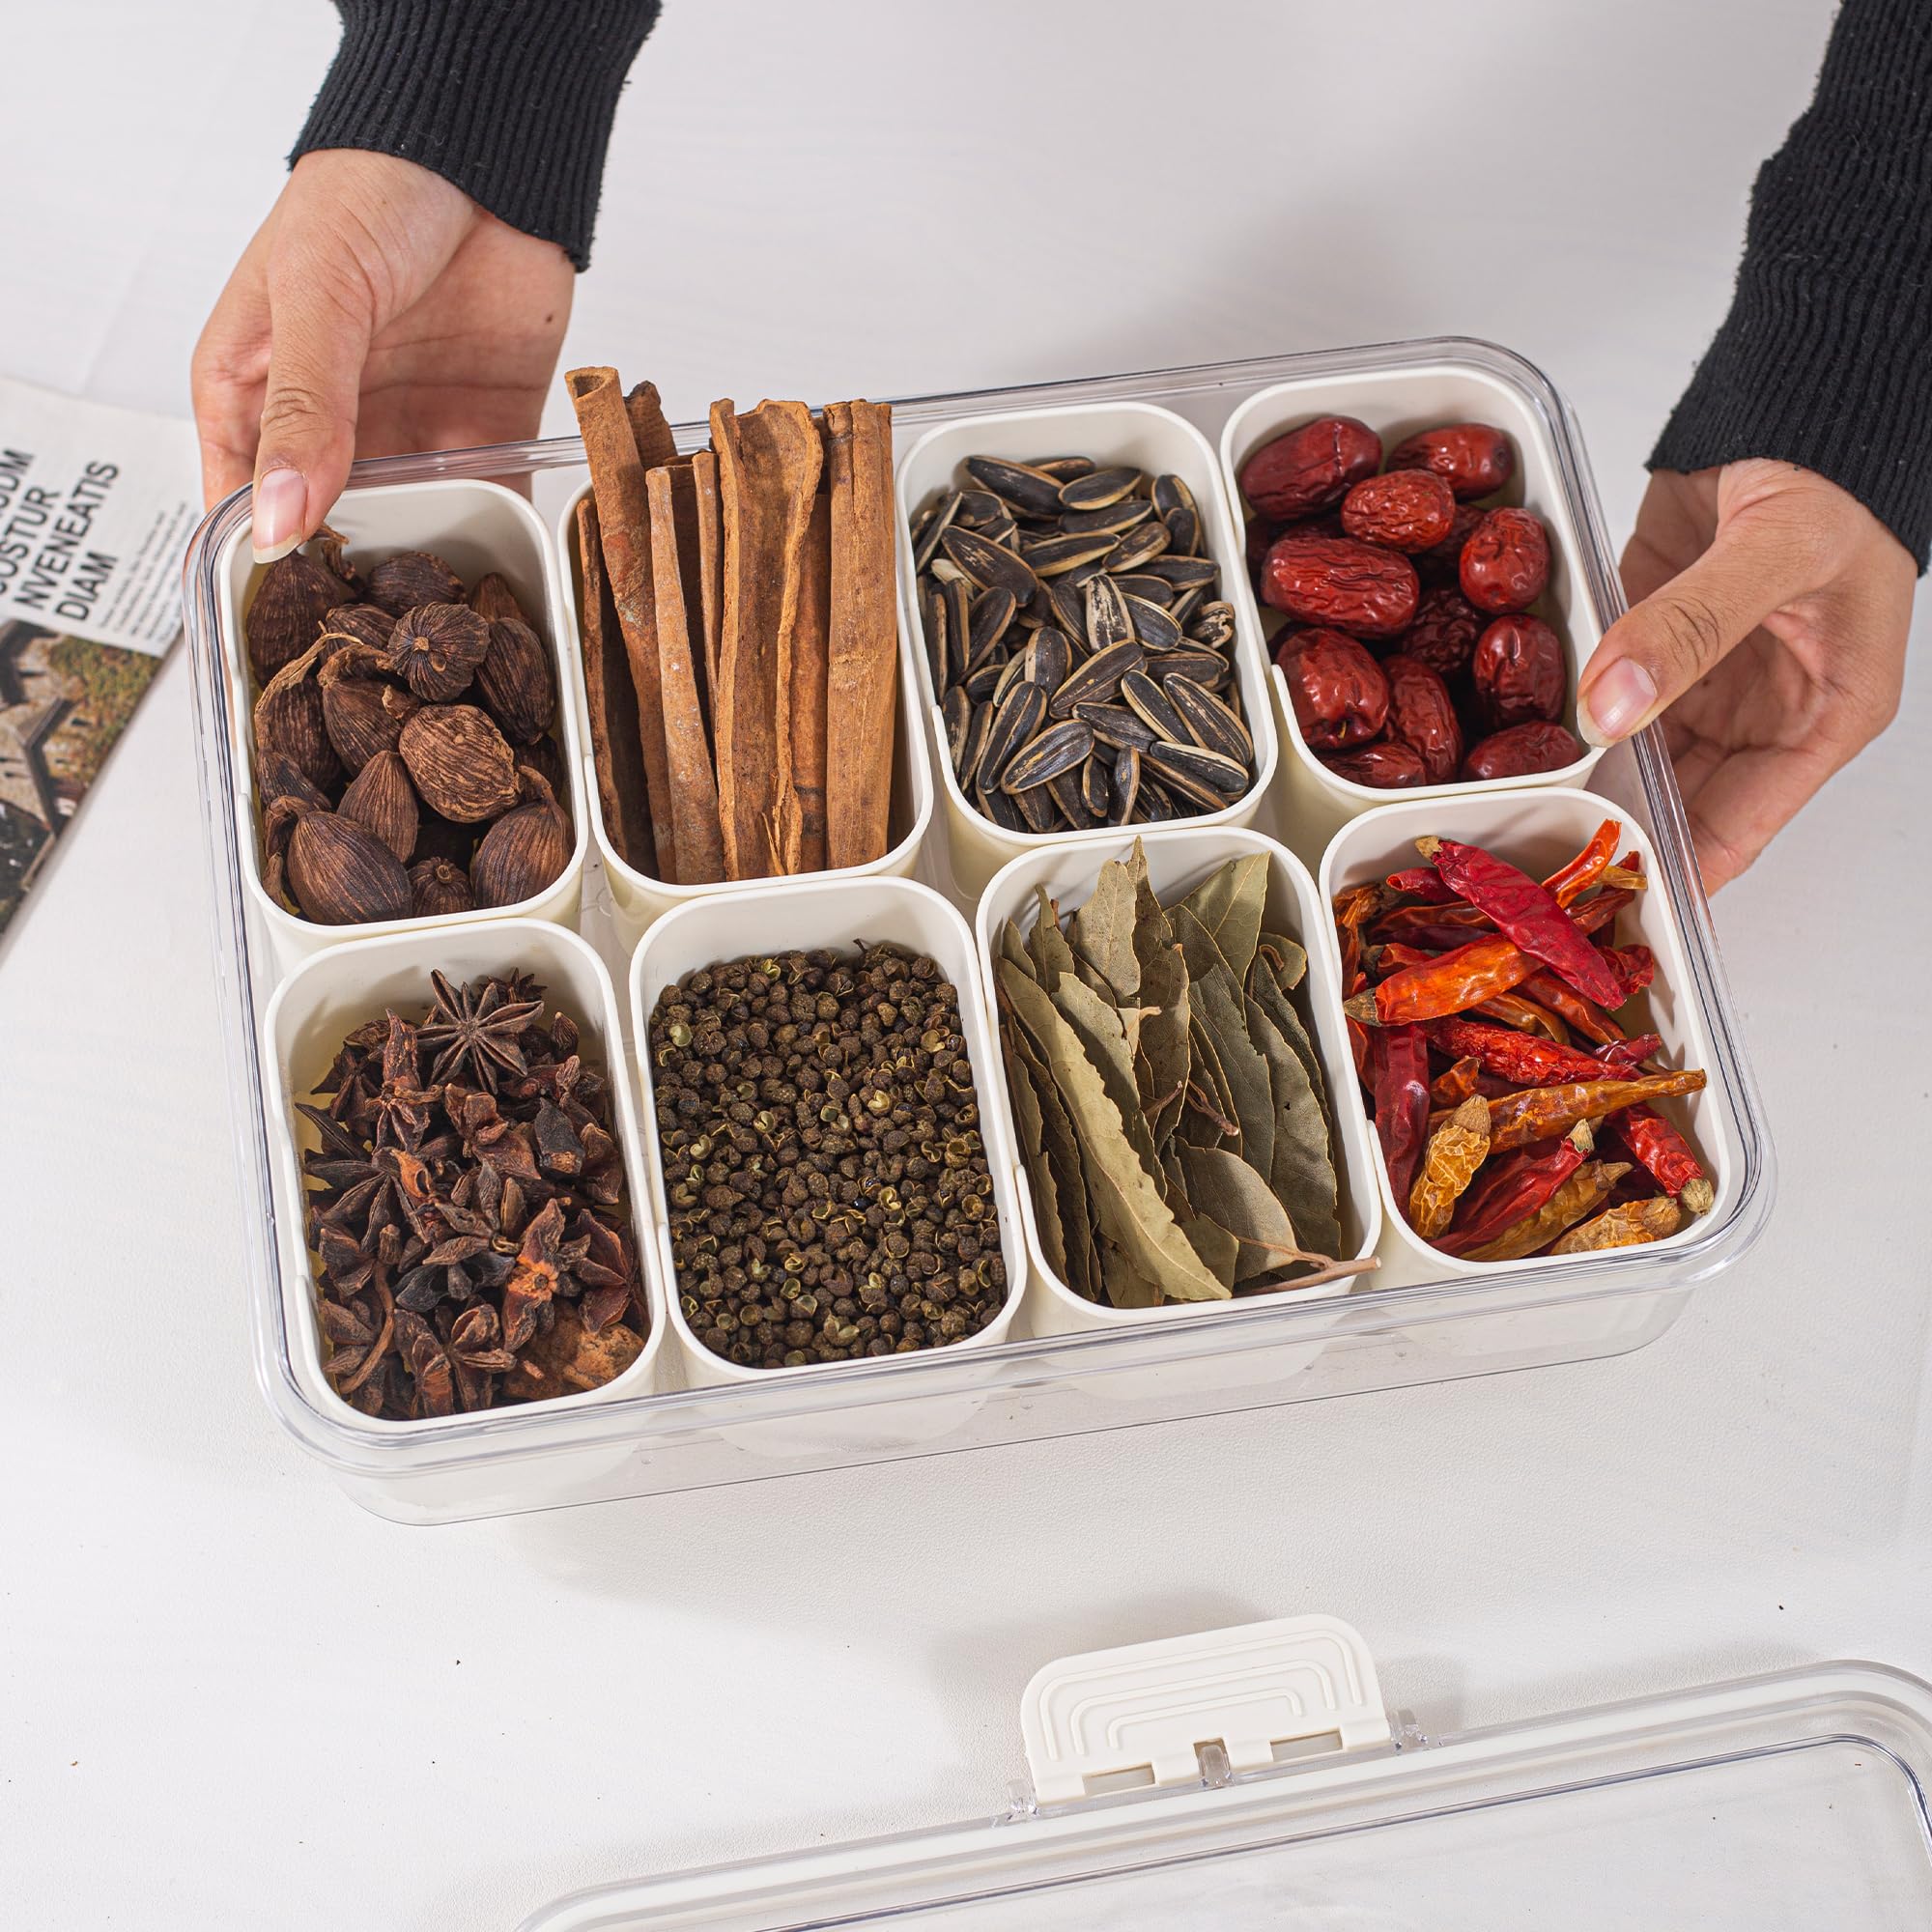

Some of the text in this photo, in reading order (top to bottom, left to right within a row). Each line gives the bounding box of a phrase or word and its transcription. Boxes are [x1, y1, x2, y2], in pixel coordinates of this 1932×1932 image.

[0, 486, 61, 595] OSTUR
[14, 461, 119, 610] NVENEATIS
[55, 552, 118, 621] DIAM
